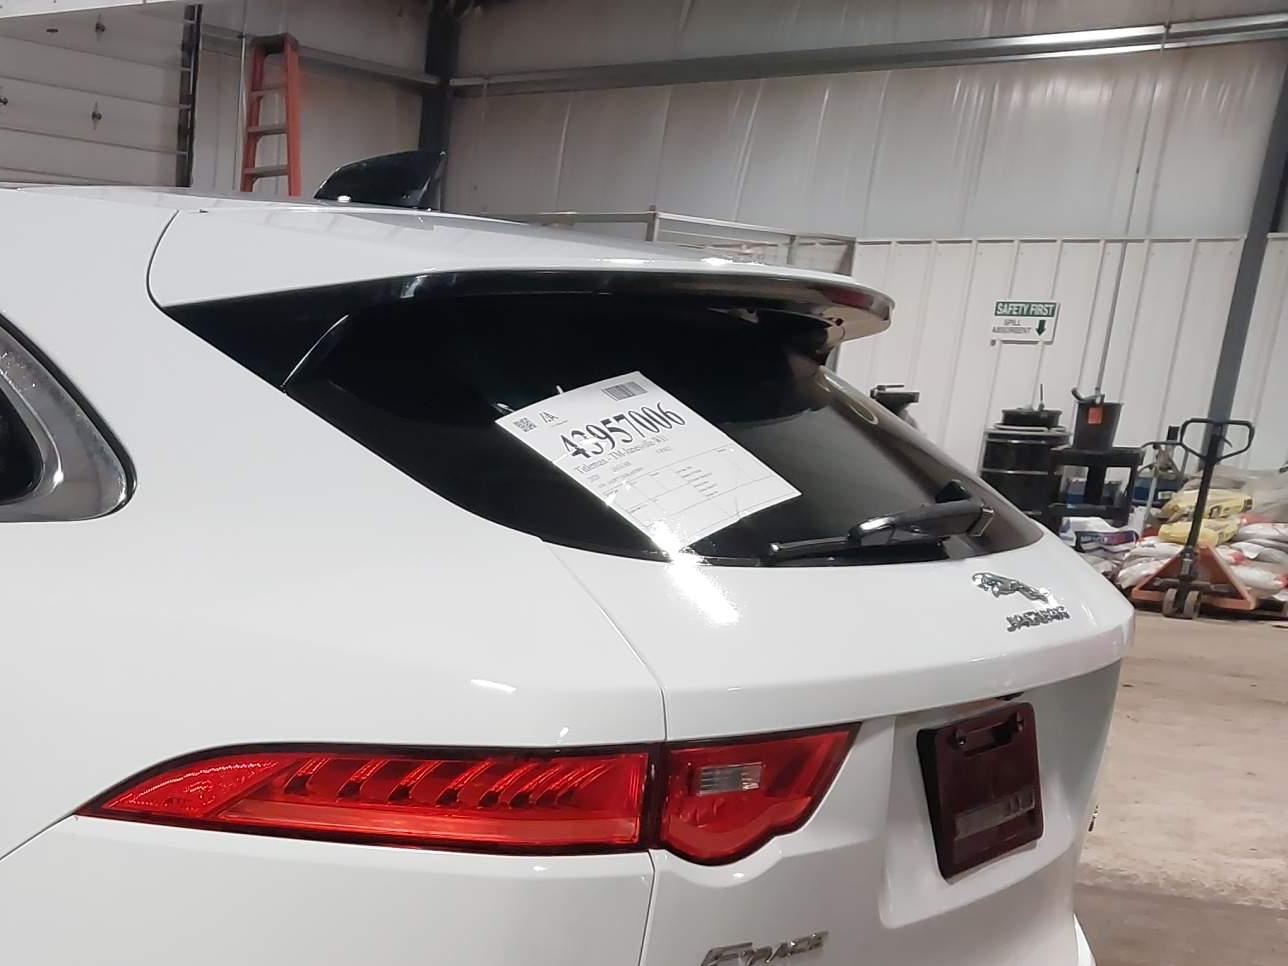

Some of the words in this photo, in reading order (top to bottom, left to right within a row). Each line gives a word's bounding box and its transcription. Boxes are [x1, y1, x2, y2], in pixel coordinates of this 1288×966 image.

[996, 302, 1030, 316] SAFETY
[1030, 303, 1054, 316] FIRST
[560, 401, 687, 460] 43957006
[1006, 605, 1071, 632] JAGUAR
